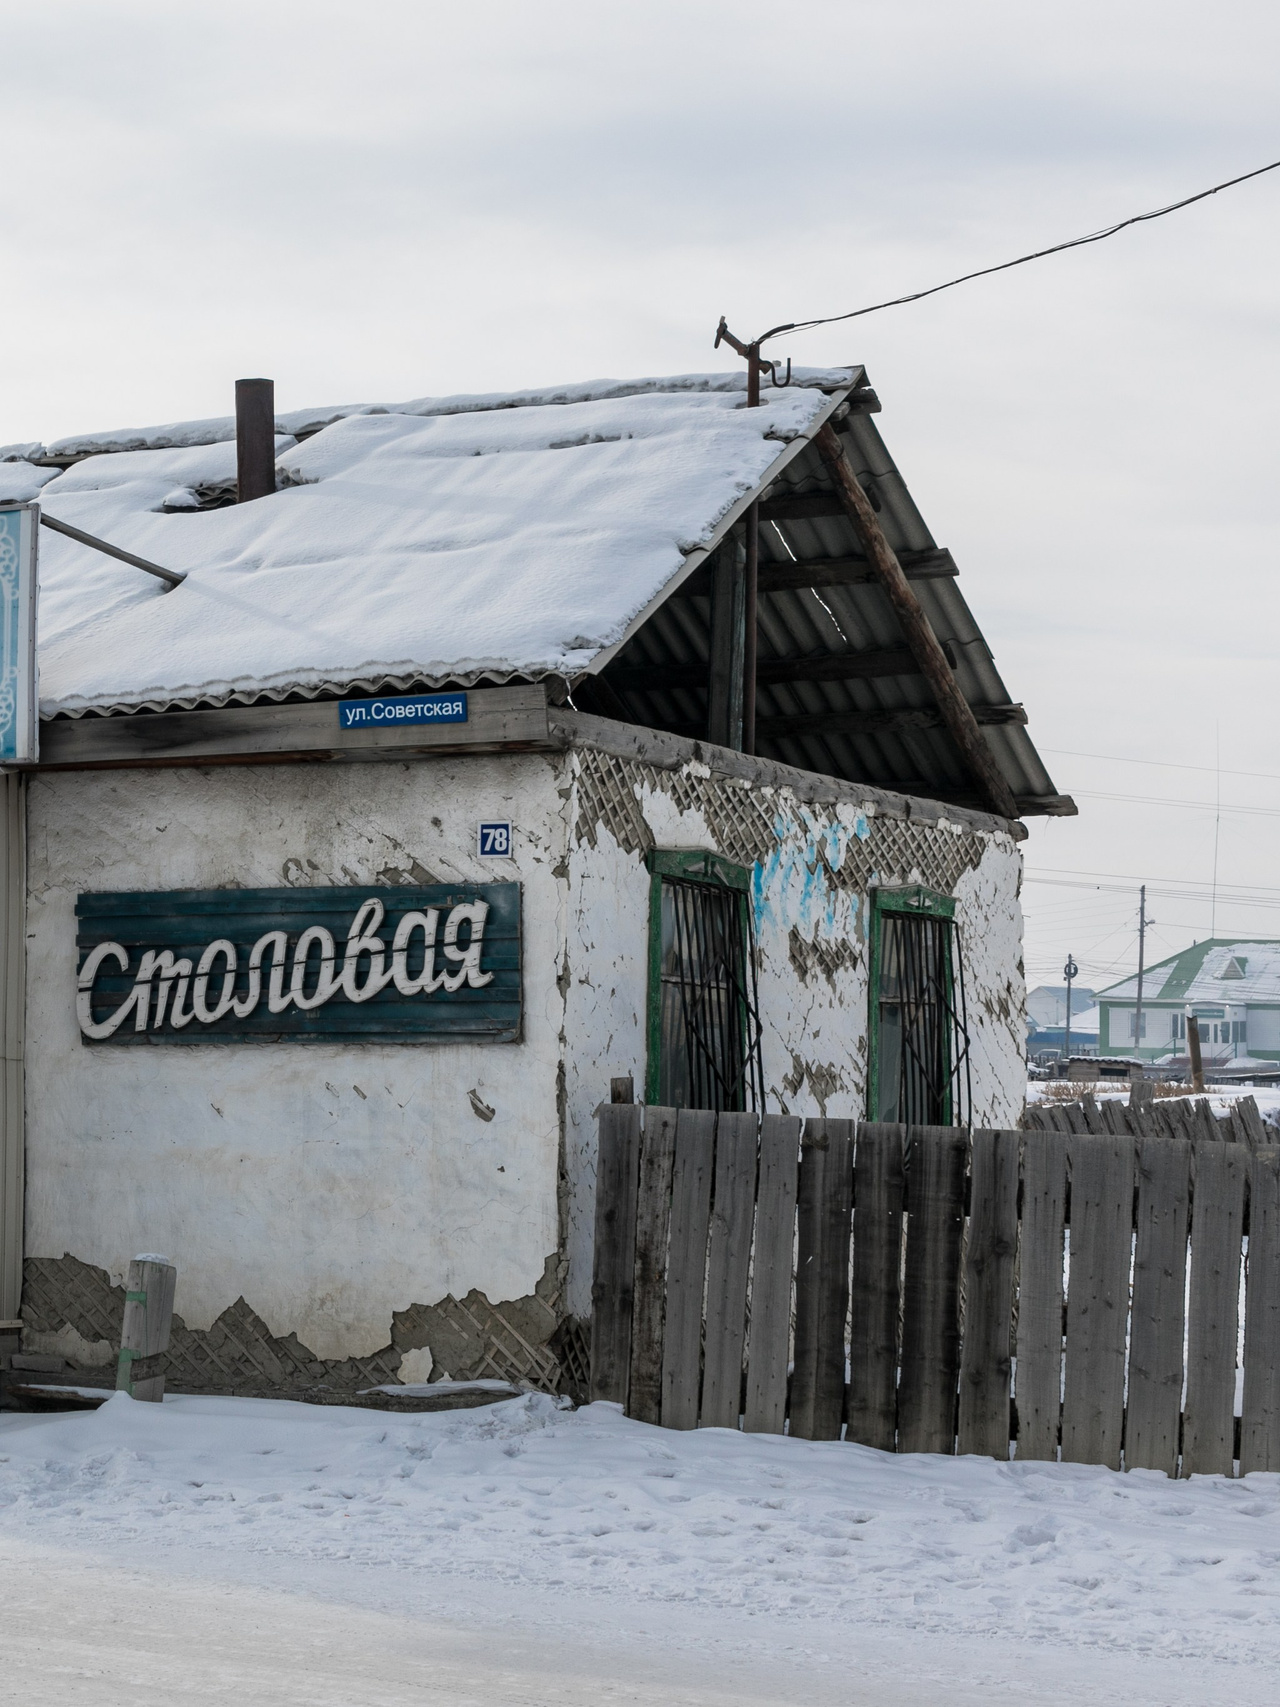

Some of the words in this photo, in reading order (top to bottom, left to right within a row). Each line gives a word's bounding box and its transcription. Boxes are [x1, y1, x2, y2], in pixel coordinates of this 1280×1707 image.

[345, 701, 463, 725] ул.Советская
[482, 828, 508, 851] 78
[76, 897, 495, 1040] Столовая
